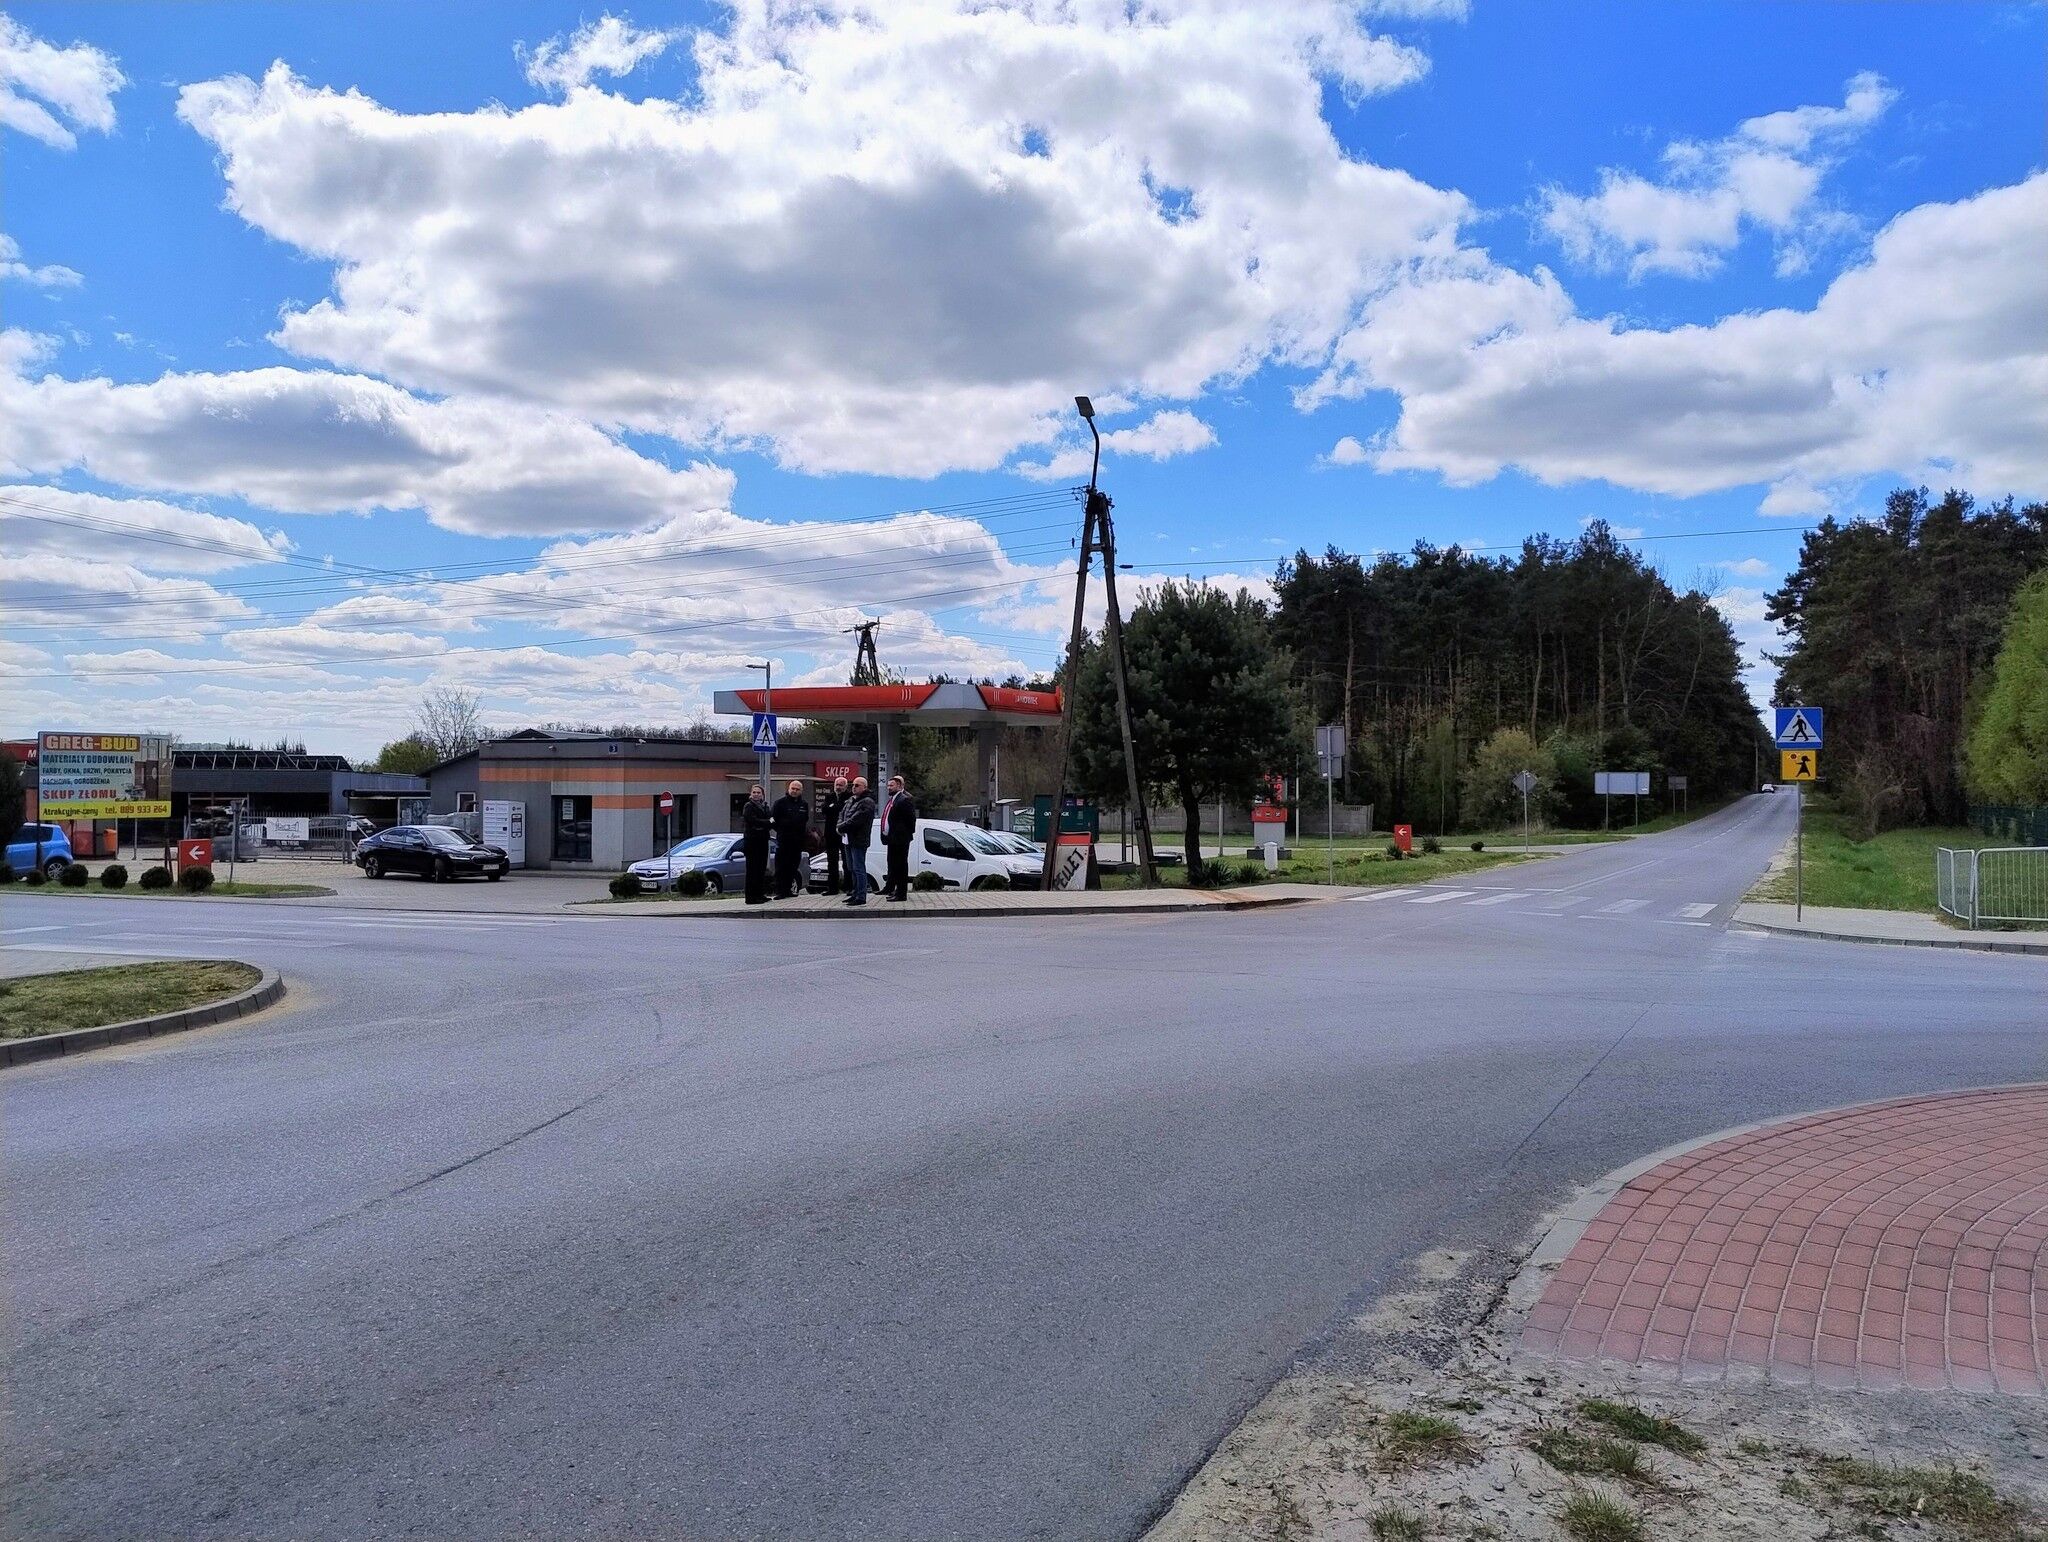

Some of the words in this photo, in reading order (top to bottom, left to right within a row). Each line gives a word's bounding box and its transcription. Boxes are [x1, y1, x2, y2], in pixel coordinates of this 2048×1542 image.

[46, 735, 138, 750] GREG-BUD
[825, 766, 850, 777] SKLEP
[42, 789, 75, 800] SKUP
[78, 789, 117, 799] ZŁOMU
[105, 806, 117, 814] tel.
[137, 804, 151, 814] 933
[1053, 848, 1084, 891] PELLET
